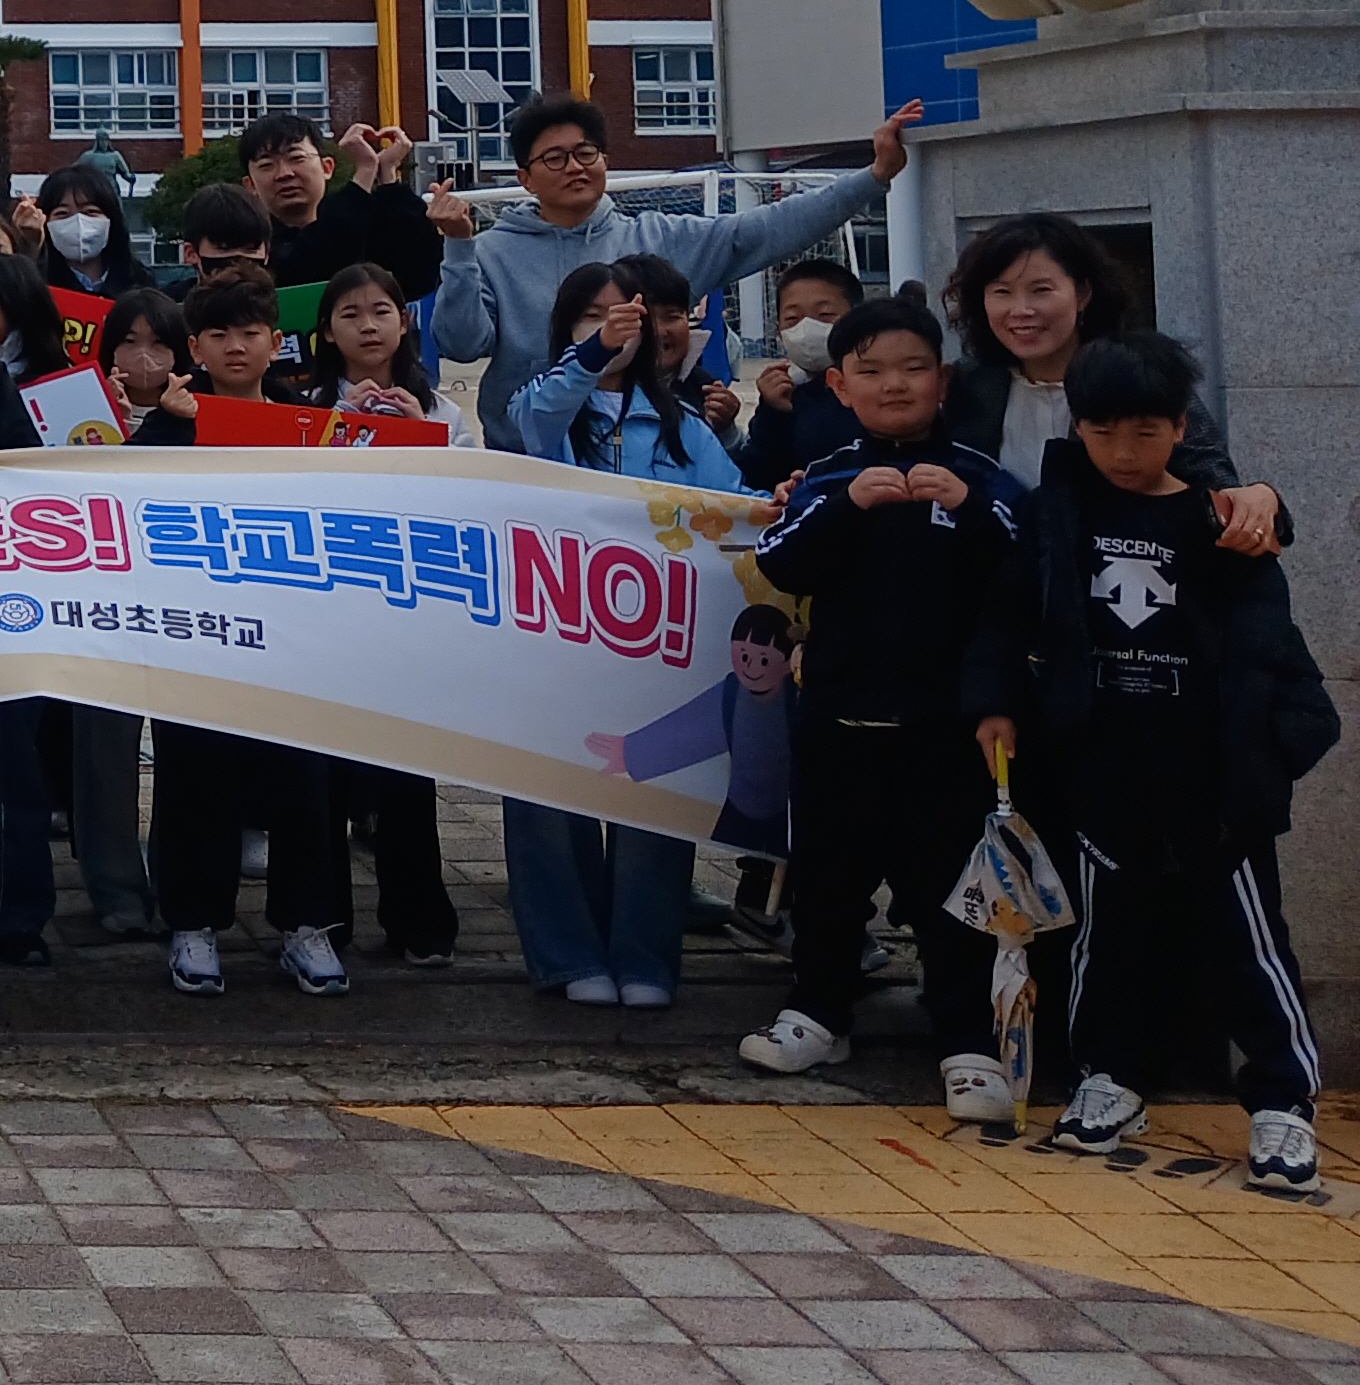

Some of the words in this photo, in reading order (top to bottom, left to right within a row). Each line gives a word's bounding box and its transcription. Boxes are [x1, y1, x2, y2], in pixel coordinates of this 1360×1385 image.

[136, 497, 501, 627] 학교폭력
[507, 520, 698, 670] NO!
[49, 599, 267, 651] 대성초등학교
[1137, 649, 1189, 666] Function
